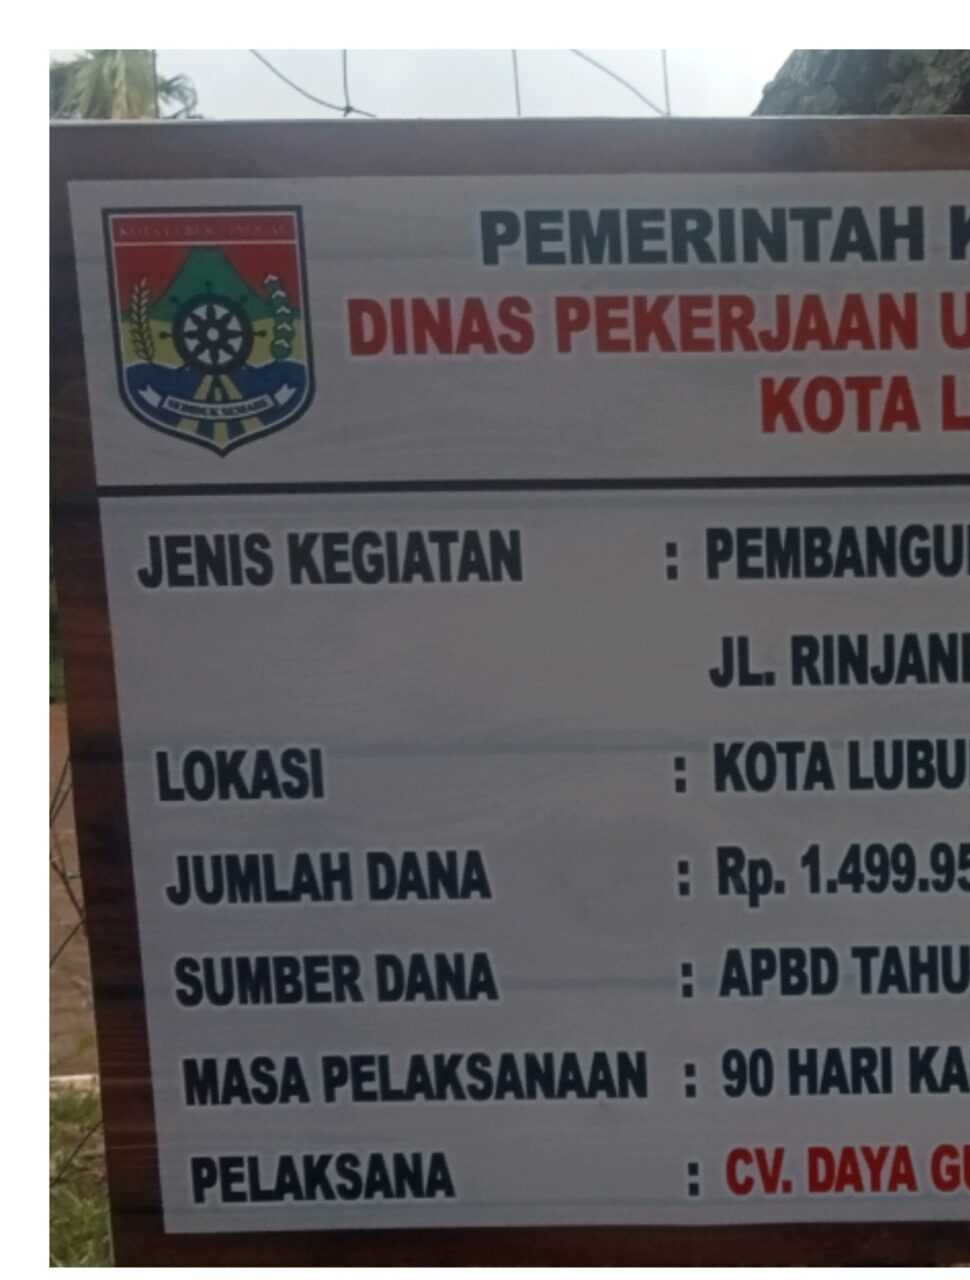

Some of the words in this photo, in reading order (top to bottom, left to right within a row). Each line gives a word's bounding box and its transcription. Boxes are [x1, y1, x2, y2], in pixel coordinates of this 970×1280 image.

[480, 205, 925, 266] PEMERINTAH
[347, 296, 535, 356] DINAS
[555, 292, 919, 353] PEKERJAAN
[761, 375, 921, 434] KOTA
[137, 532, 274, 589] JENIS
[287, 529, 523, 585] KEGIATAN
[708, 635, 776, 688] JL.
[155, 748, 324, 802] LOKASI
[713, 740, 835, 793] KOTA
[165, 852, 353, 906] JUMLAH
[366, 849, 492, 901] DANA
[716, 846, 786, 908] Rp.
[174, 954, 364, 1007] SUMBER
[375, 952, 499, 1003] DANA
[719, 947, 839, 997] APBD
[182, 1056, 311, 1106] MASA
[321, 1051, 648, 1103] PELAKSANAAN
[722, 1048, 774, 1098] 90
[788, 1046, 893, 1096] HARI
[190, 1152, 456, 1204] PELAKSANA
[725, 1147, 793, 1196] CV.
[807, 1145, 918, 1193] DAYA
